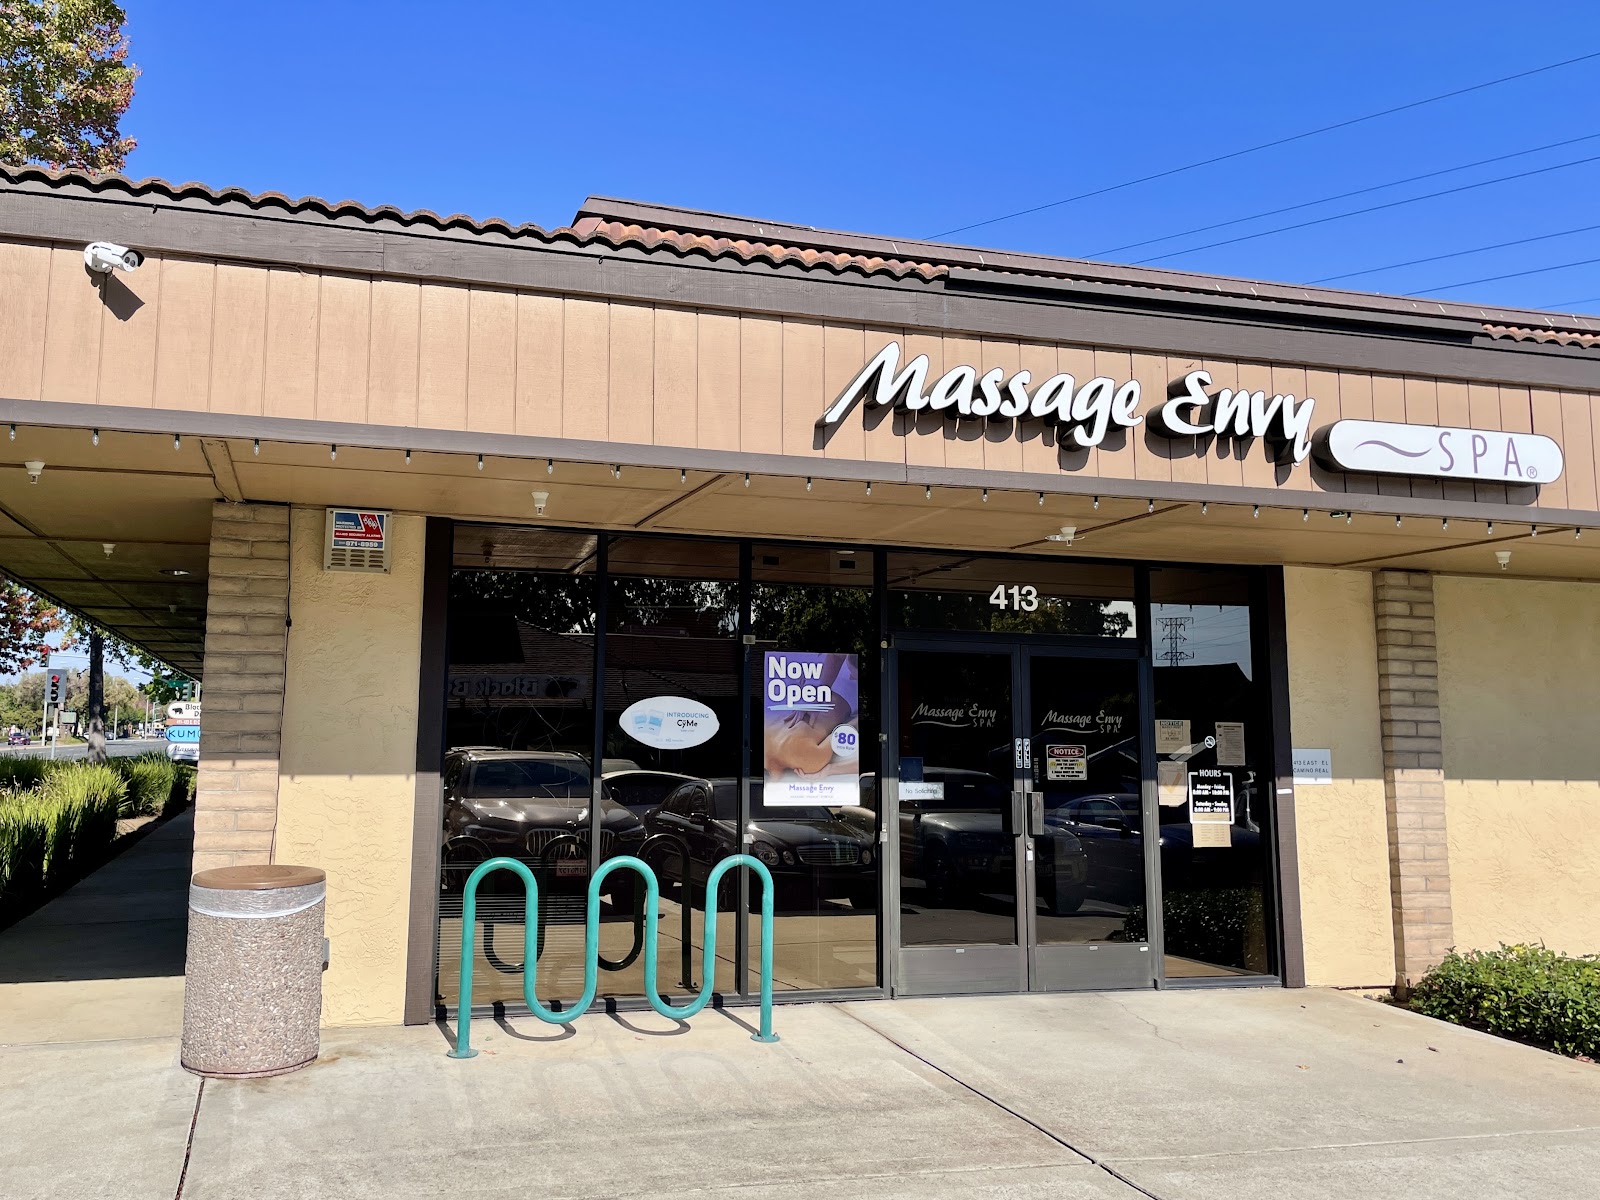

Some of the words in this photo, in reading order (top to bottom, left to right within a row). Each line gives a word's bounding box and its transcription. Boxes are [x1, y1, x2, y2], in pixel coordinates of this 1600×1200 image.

[824, 340, 1143, 447] Massage
[1163, 370, 1316, 466] Envy
[1438, 431, 1523, 477] SPA
[989, 584, 1039, 612] 413
[768, 656, 823, 679] Now
[768, 679, 832, 708] Open
[910, 702, 964, 722] Massage
[968, 703, 997, 722] Envy
[1040, 710, 1092, 728] Massage
[1096, 710, 1123, 728] Envy
[972, 718, 992, 728] SPA
[1100, 724, 1119, 734] SPA
[1199, 770, 1222, 778] HOURS
[788, 784, 818, 793] Massage
[819, 784, 834, 793] Envy
